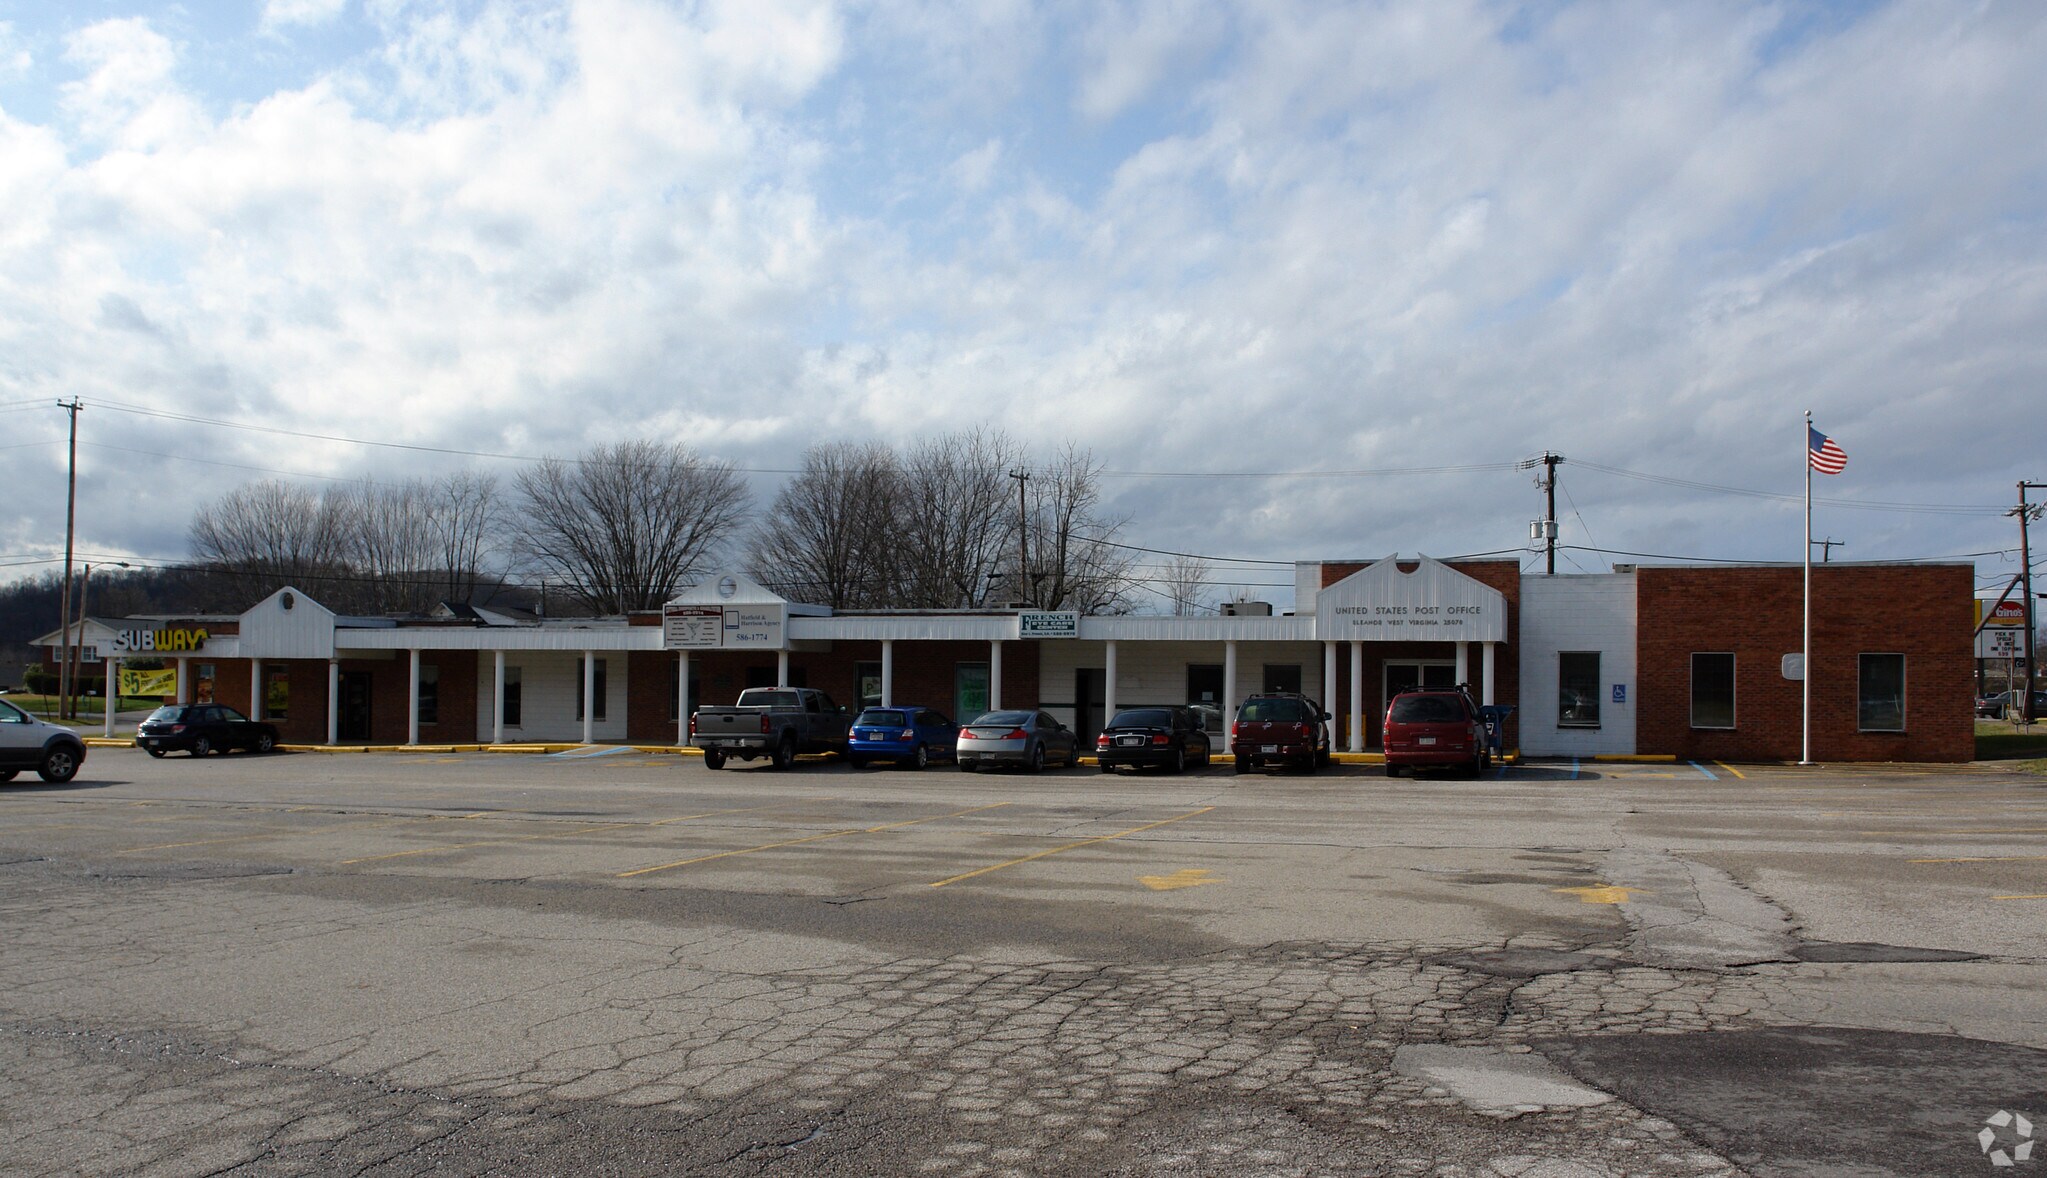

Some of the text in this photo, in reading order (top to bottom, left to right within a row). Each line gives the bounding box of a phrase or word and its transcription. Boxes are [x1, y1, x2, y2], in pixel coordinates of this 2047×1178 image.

[1335, 606, 1481, 615] UNITED STATES POST OFFICE
[1021, 614, 1074, 630] FRENCH
[112, 628, 209, 651] SUBWAY
[736, 633, 768, 641] 586-1774
[124, 672, 139, 694] $5
